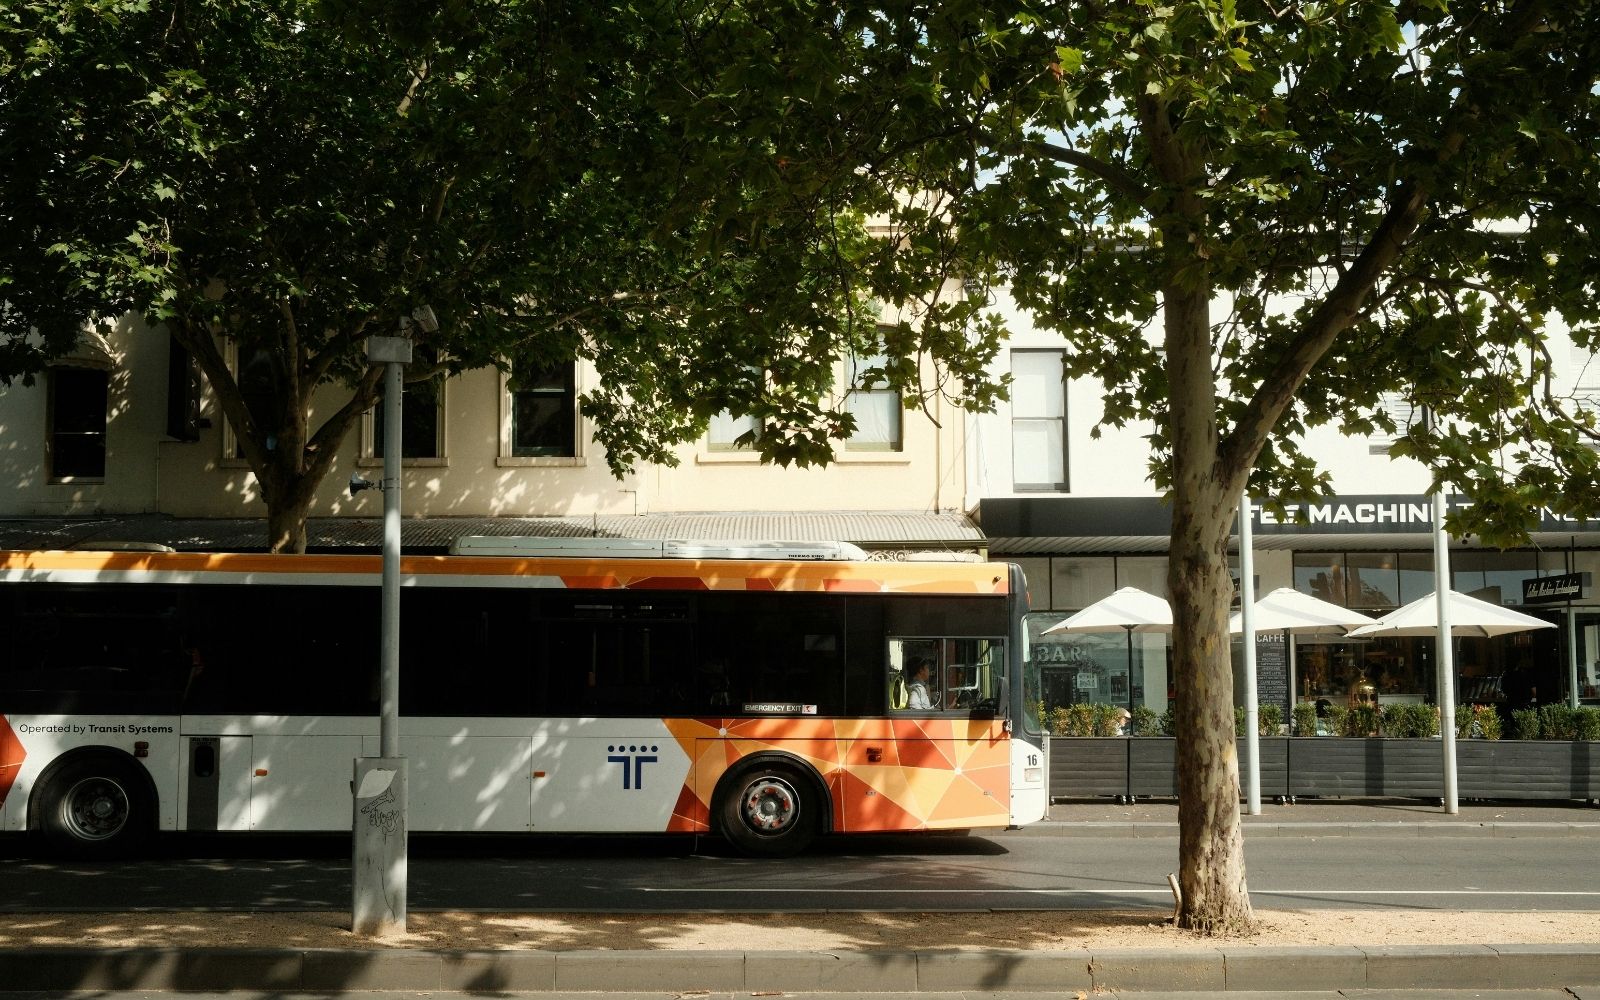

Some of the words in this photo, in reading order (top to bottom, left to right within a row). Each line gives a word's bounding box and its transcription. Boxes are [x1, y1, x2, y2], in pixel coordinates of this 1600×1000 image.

[1309, 503, 1449, 523] MACHIN
[1037, 646, 1081, 662] BAR
[744, 704, 785, 712] EMERGENCY
[19, 724, 71, 734] Operated
[73, 724, 86, 734] by
[88, 724, 126, 733] Transit
[128, 725, 173, 735] Systems
[1027, 754, 1038, 766] 16
